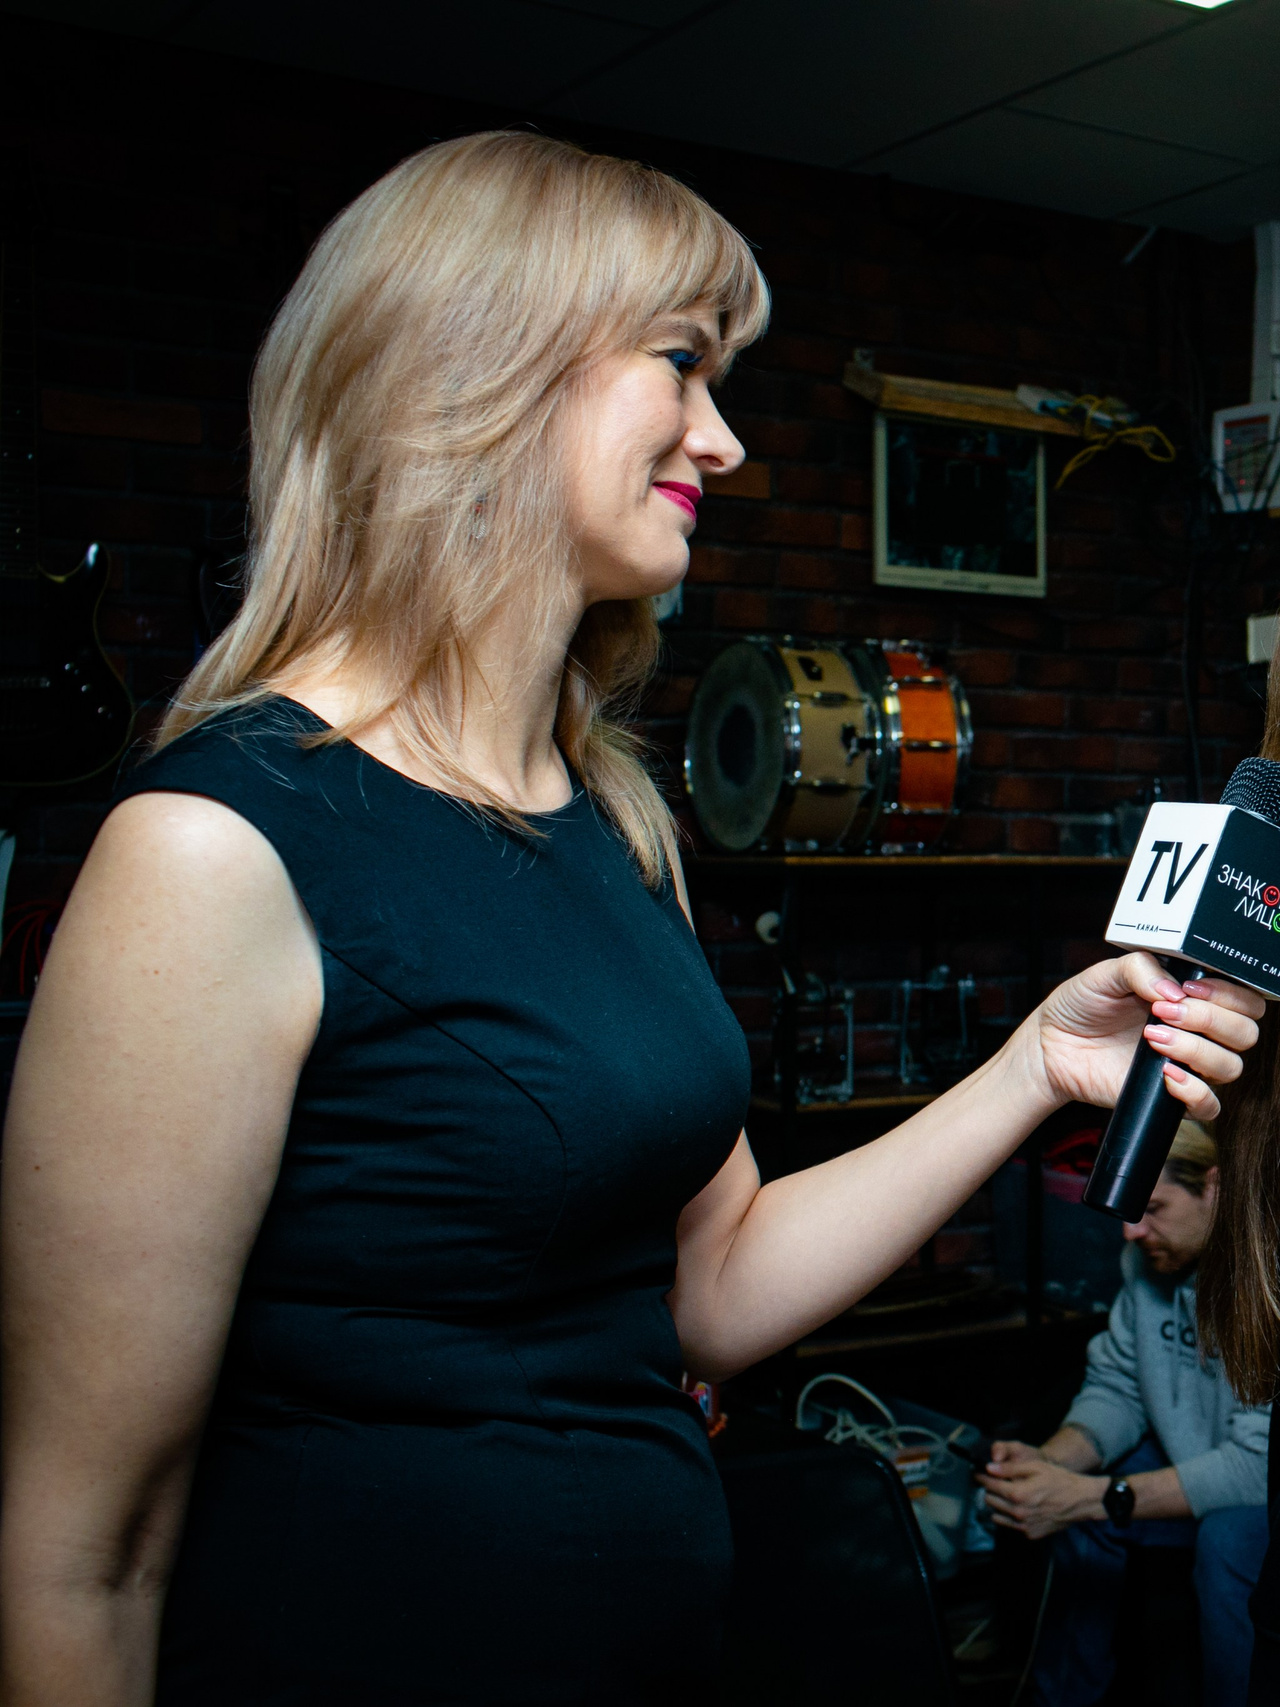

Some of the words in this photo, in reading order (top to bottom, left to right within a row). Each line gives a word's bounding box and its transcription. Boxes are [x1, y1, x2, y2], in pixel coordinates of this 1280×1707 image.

[1137, 840, 1209, 904] TV
[1135, 923, 1160, 934] КАНАЛ
[1209, 940, 1260, 967] ИНТЕРНЕТ
